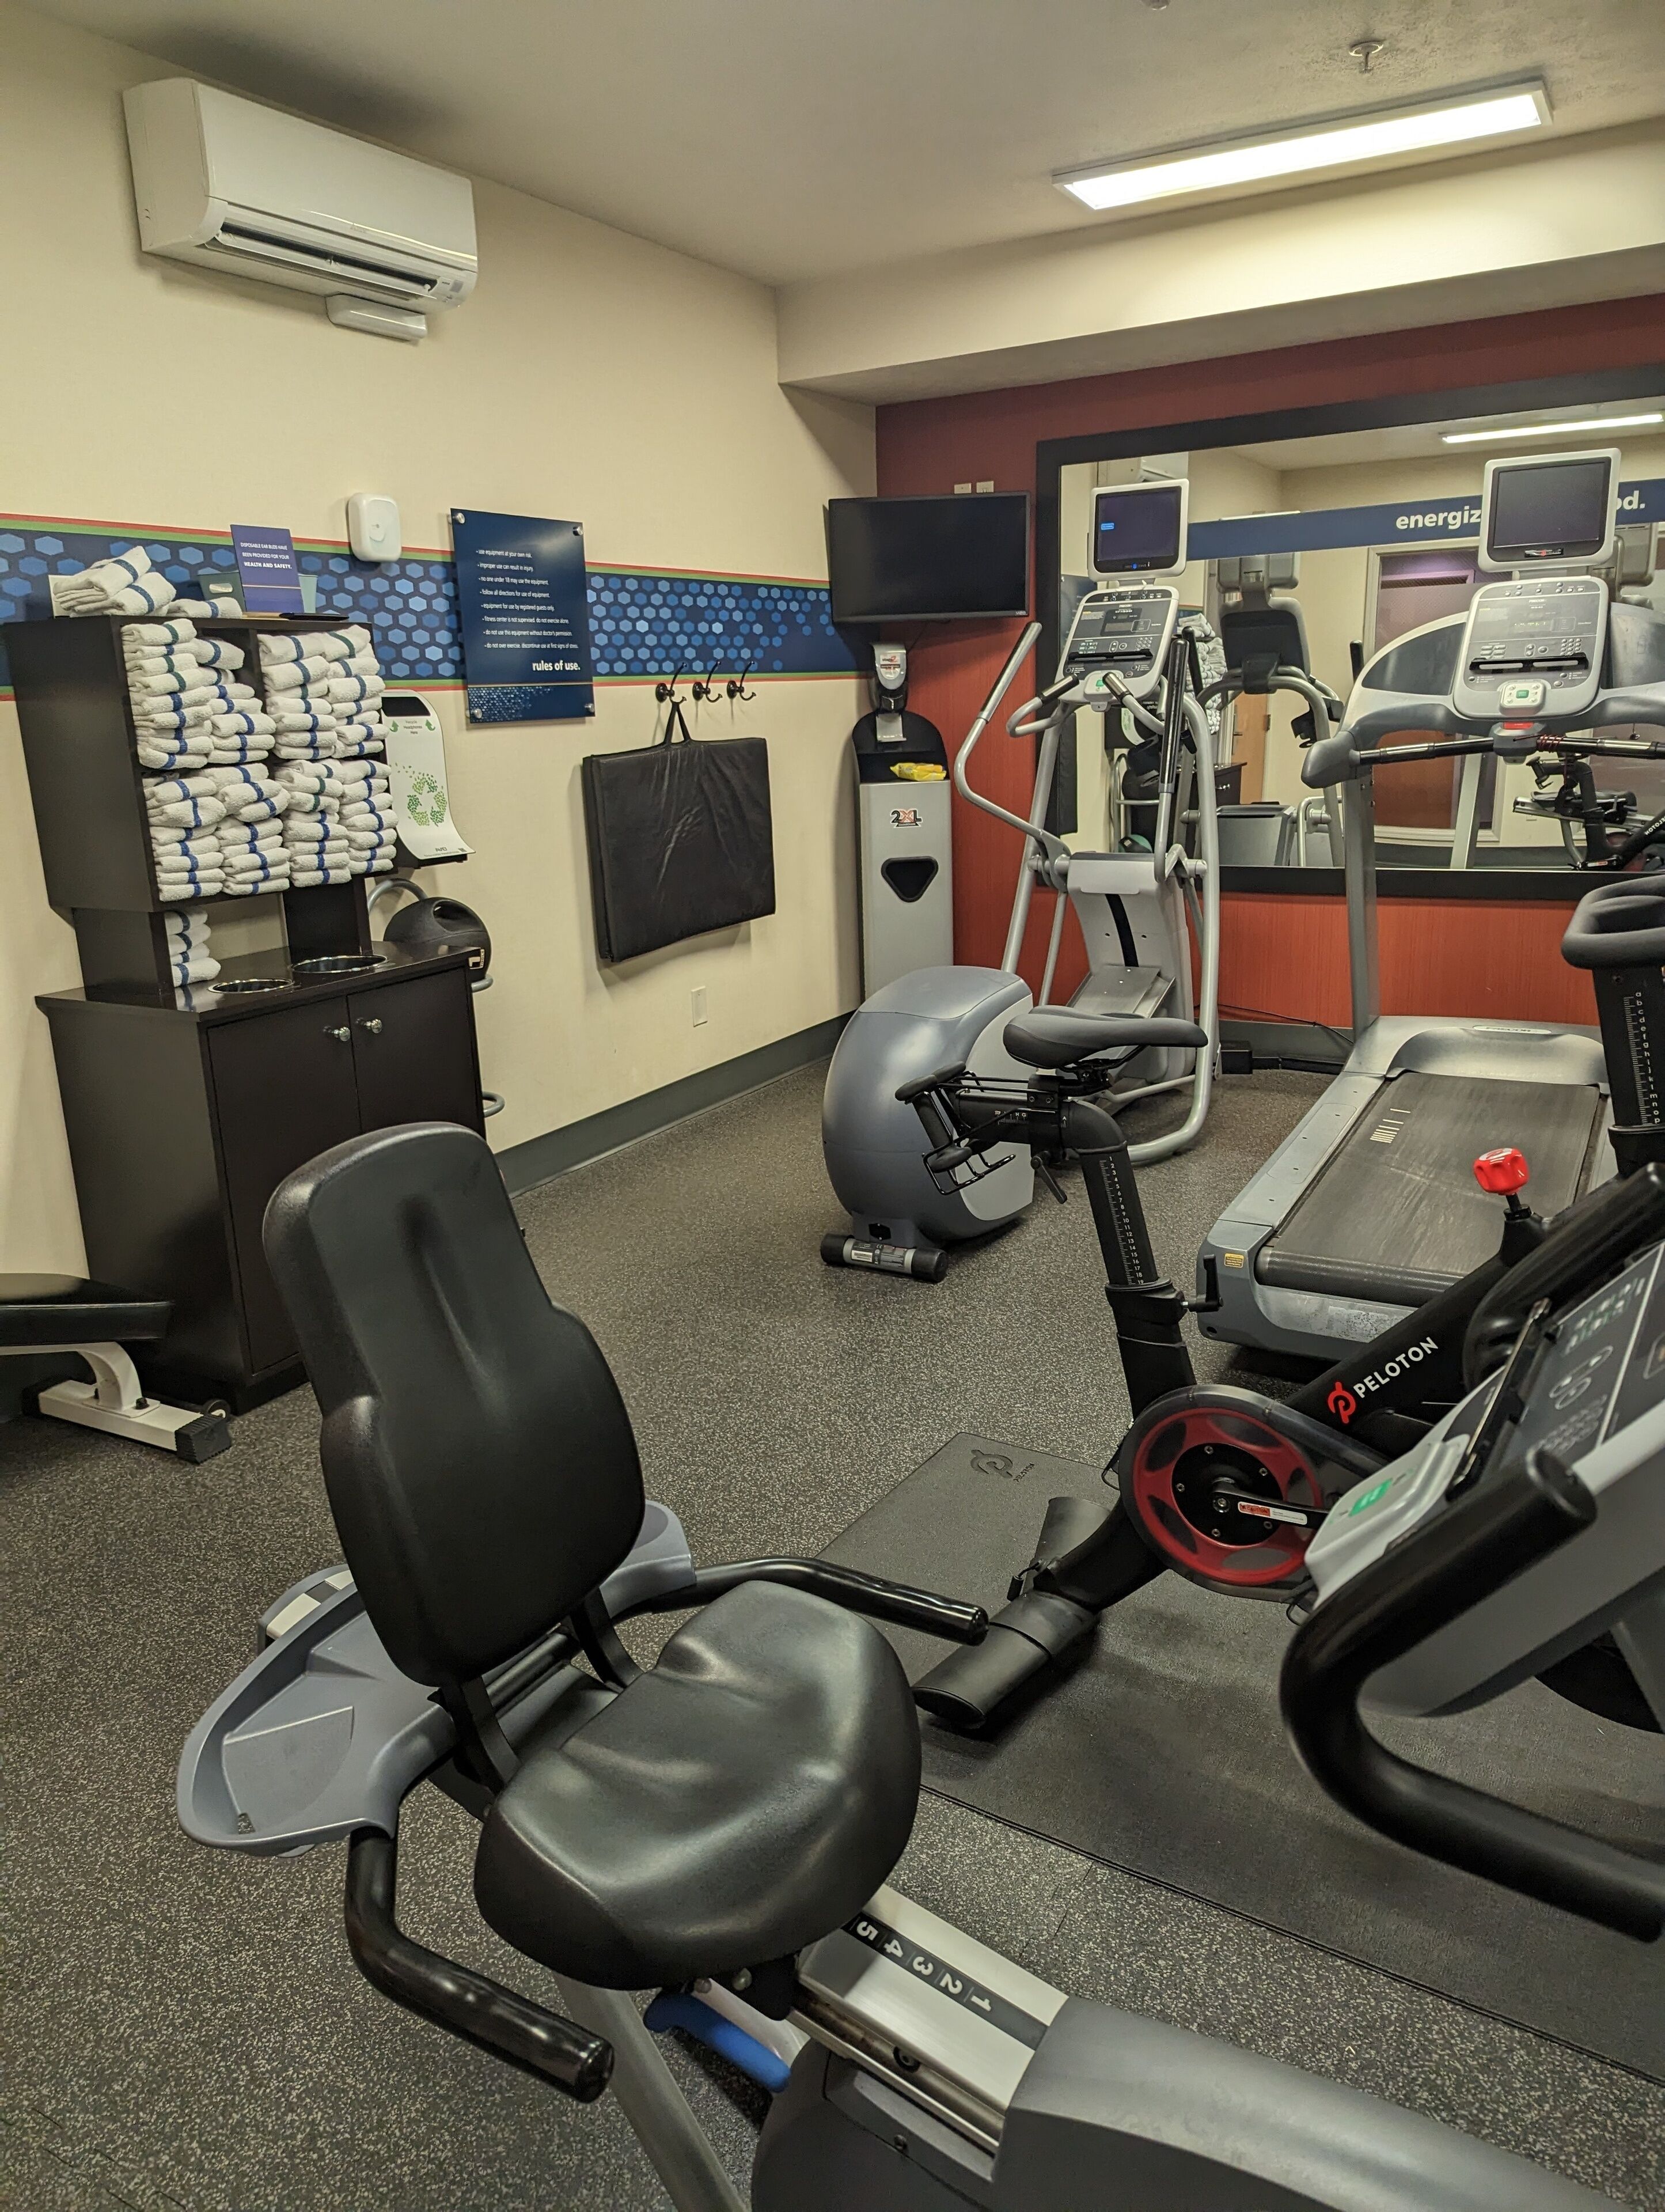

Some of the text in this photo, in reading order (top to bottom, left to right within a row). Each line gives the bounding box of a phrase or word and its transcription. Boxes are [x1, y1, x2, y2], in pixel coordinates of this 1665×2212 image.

[1395, 505, 1481, 530] energiz
[532, 660, 581, 671] rules of use.
[891, 809, 922, 823] 2XL
[1353, 1336, 1439, 1399] PELOTON
[856, 1921, 879, 1941] 5
[882, 1938, 904, 1959] 4
[912, 1956, 934, 1976] 3
[939, 1972, 964, 1995] 2
[970, 1994, 992, 2012] 1
